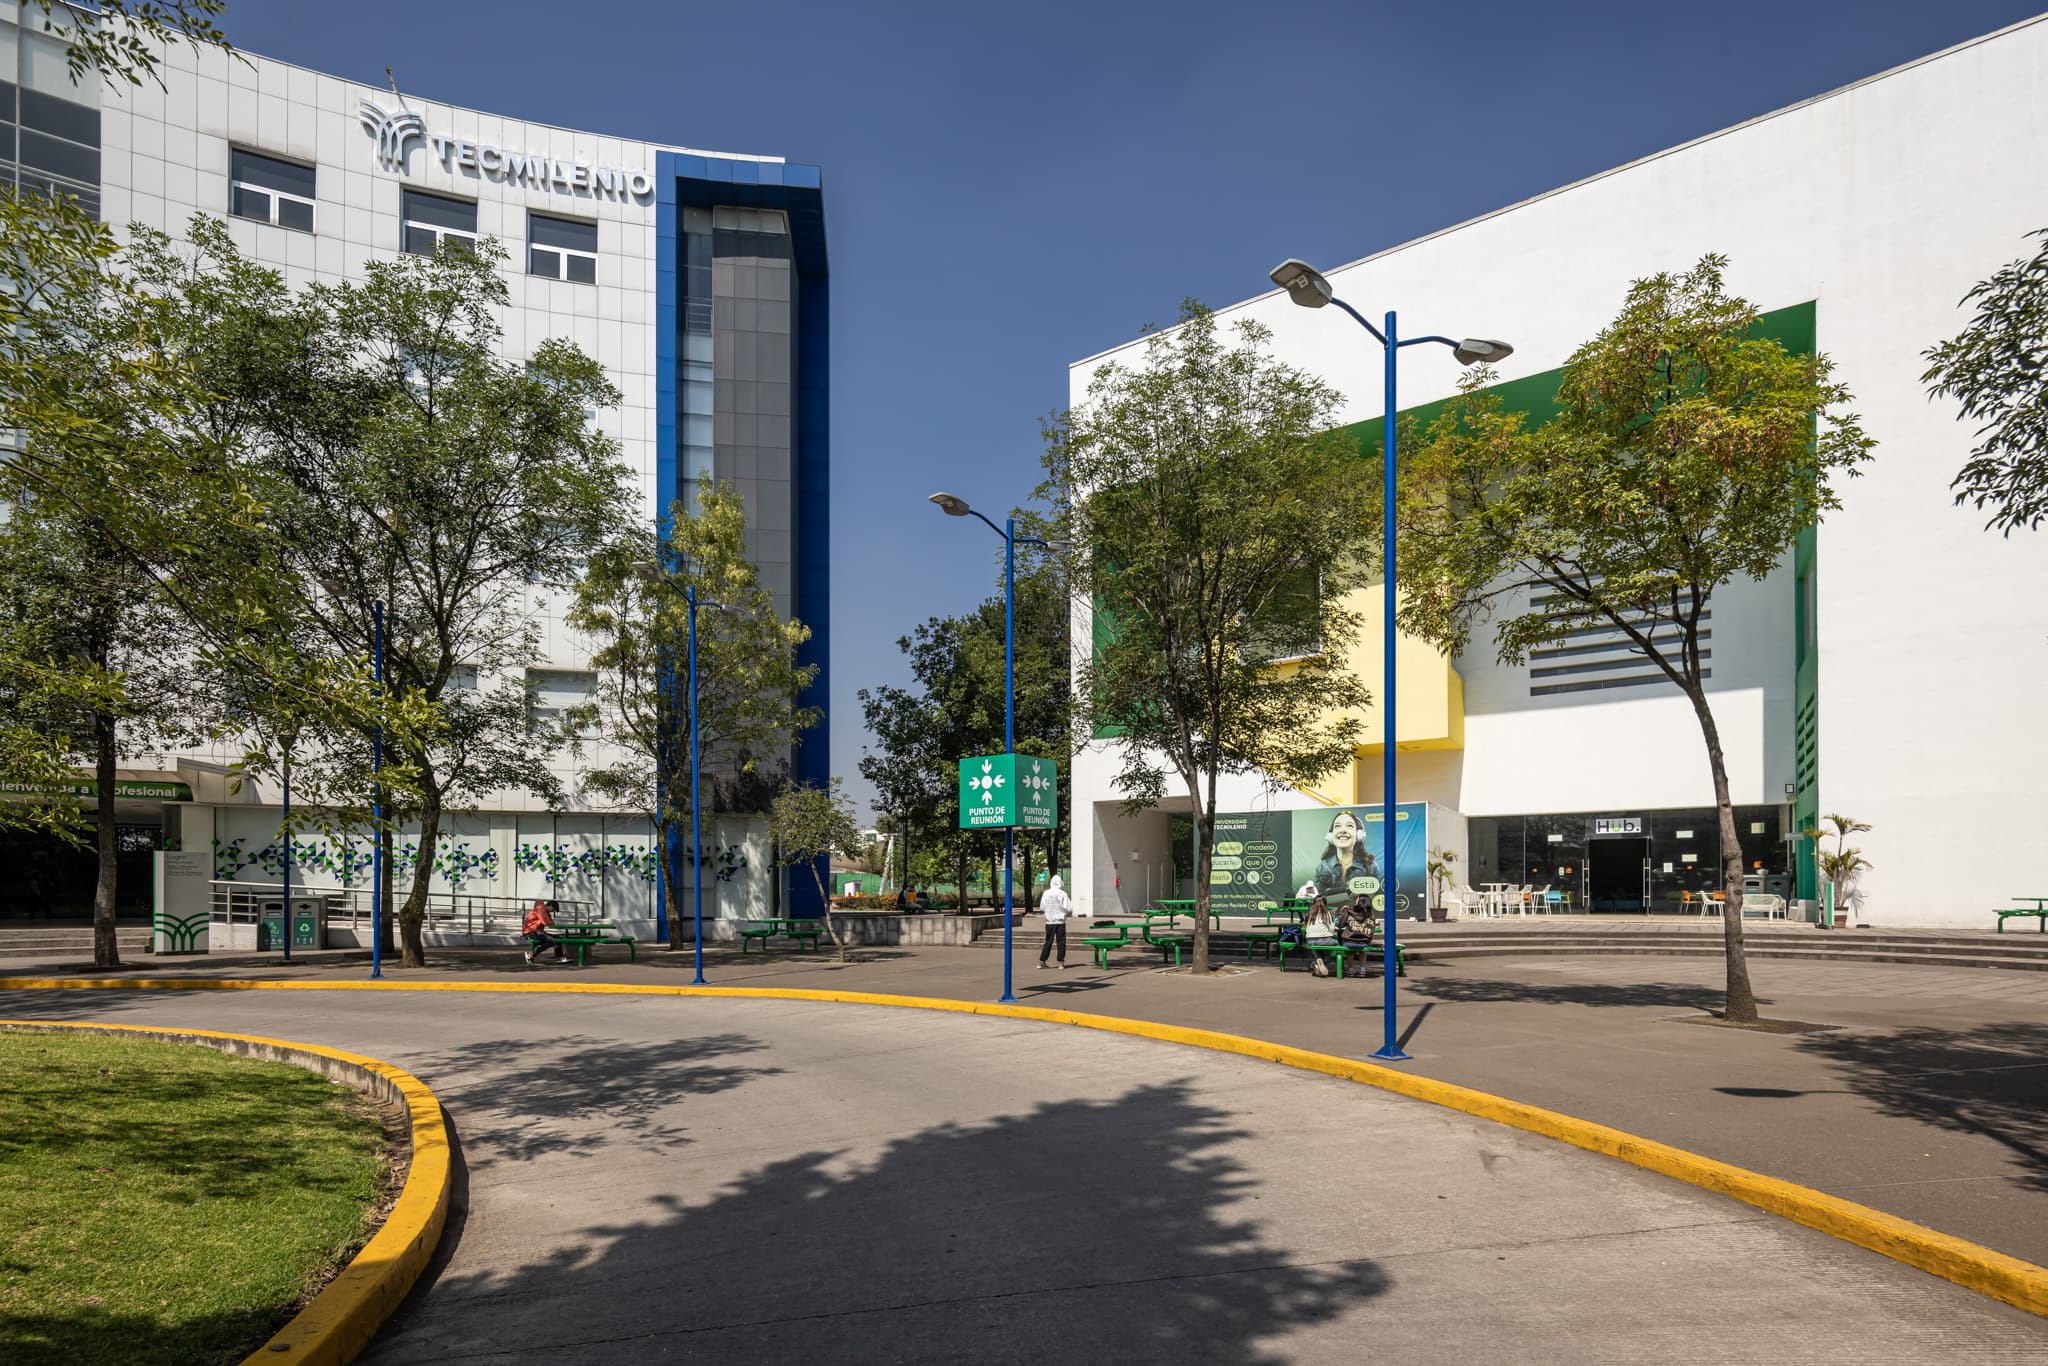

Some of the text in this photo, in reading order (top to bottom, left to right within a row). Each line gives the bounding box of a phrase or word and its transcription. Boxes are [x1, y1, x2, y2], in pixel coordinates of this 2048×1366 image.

[431, 134, 652, 195] TECMILENIO
[80, 786, 90, 794] a
[114, 785, 176, 797] ofesional
[969, 806, 1005, 816] PUNTO DE
[1023, 807, 1051, 816] PUNTO DE
[971, 815, 1004, 824] REUNIÓN
[1024, 815, 1050, 825] REUNIÓN
[1210, 873, 1230, 881] dapta
